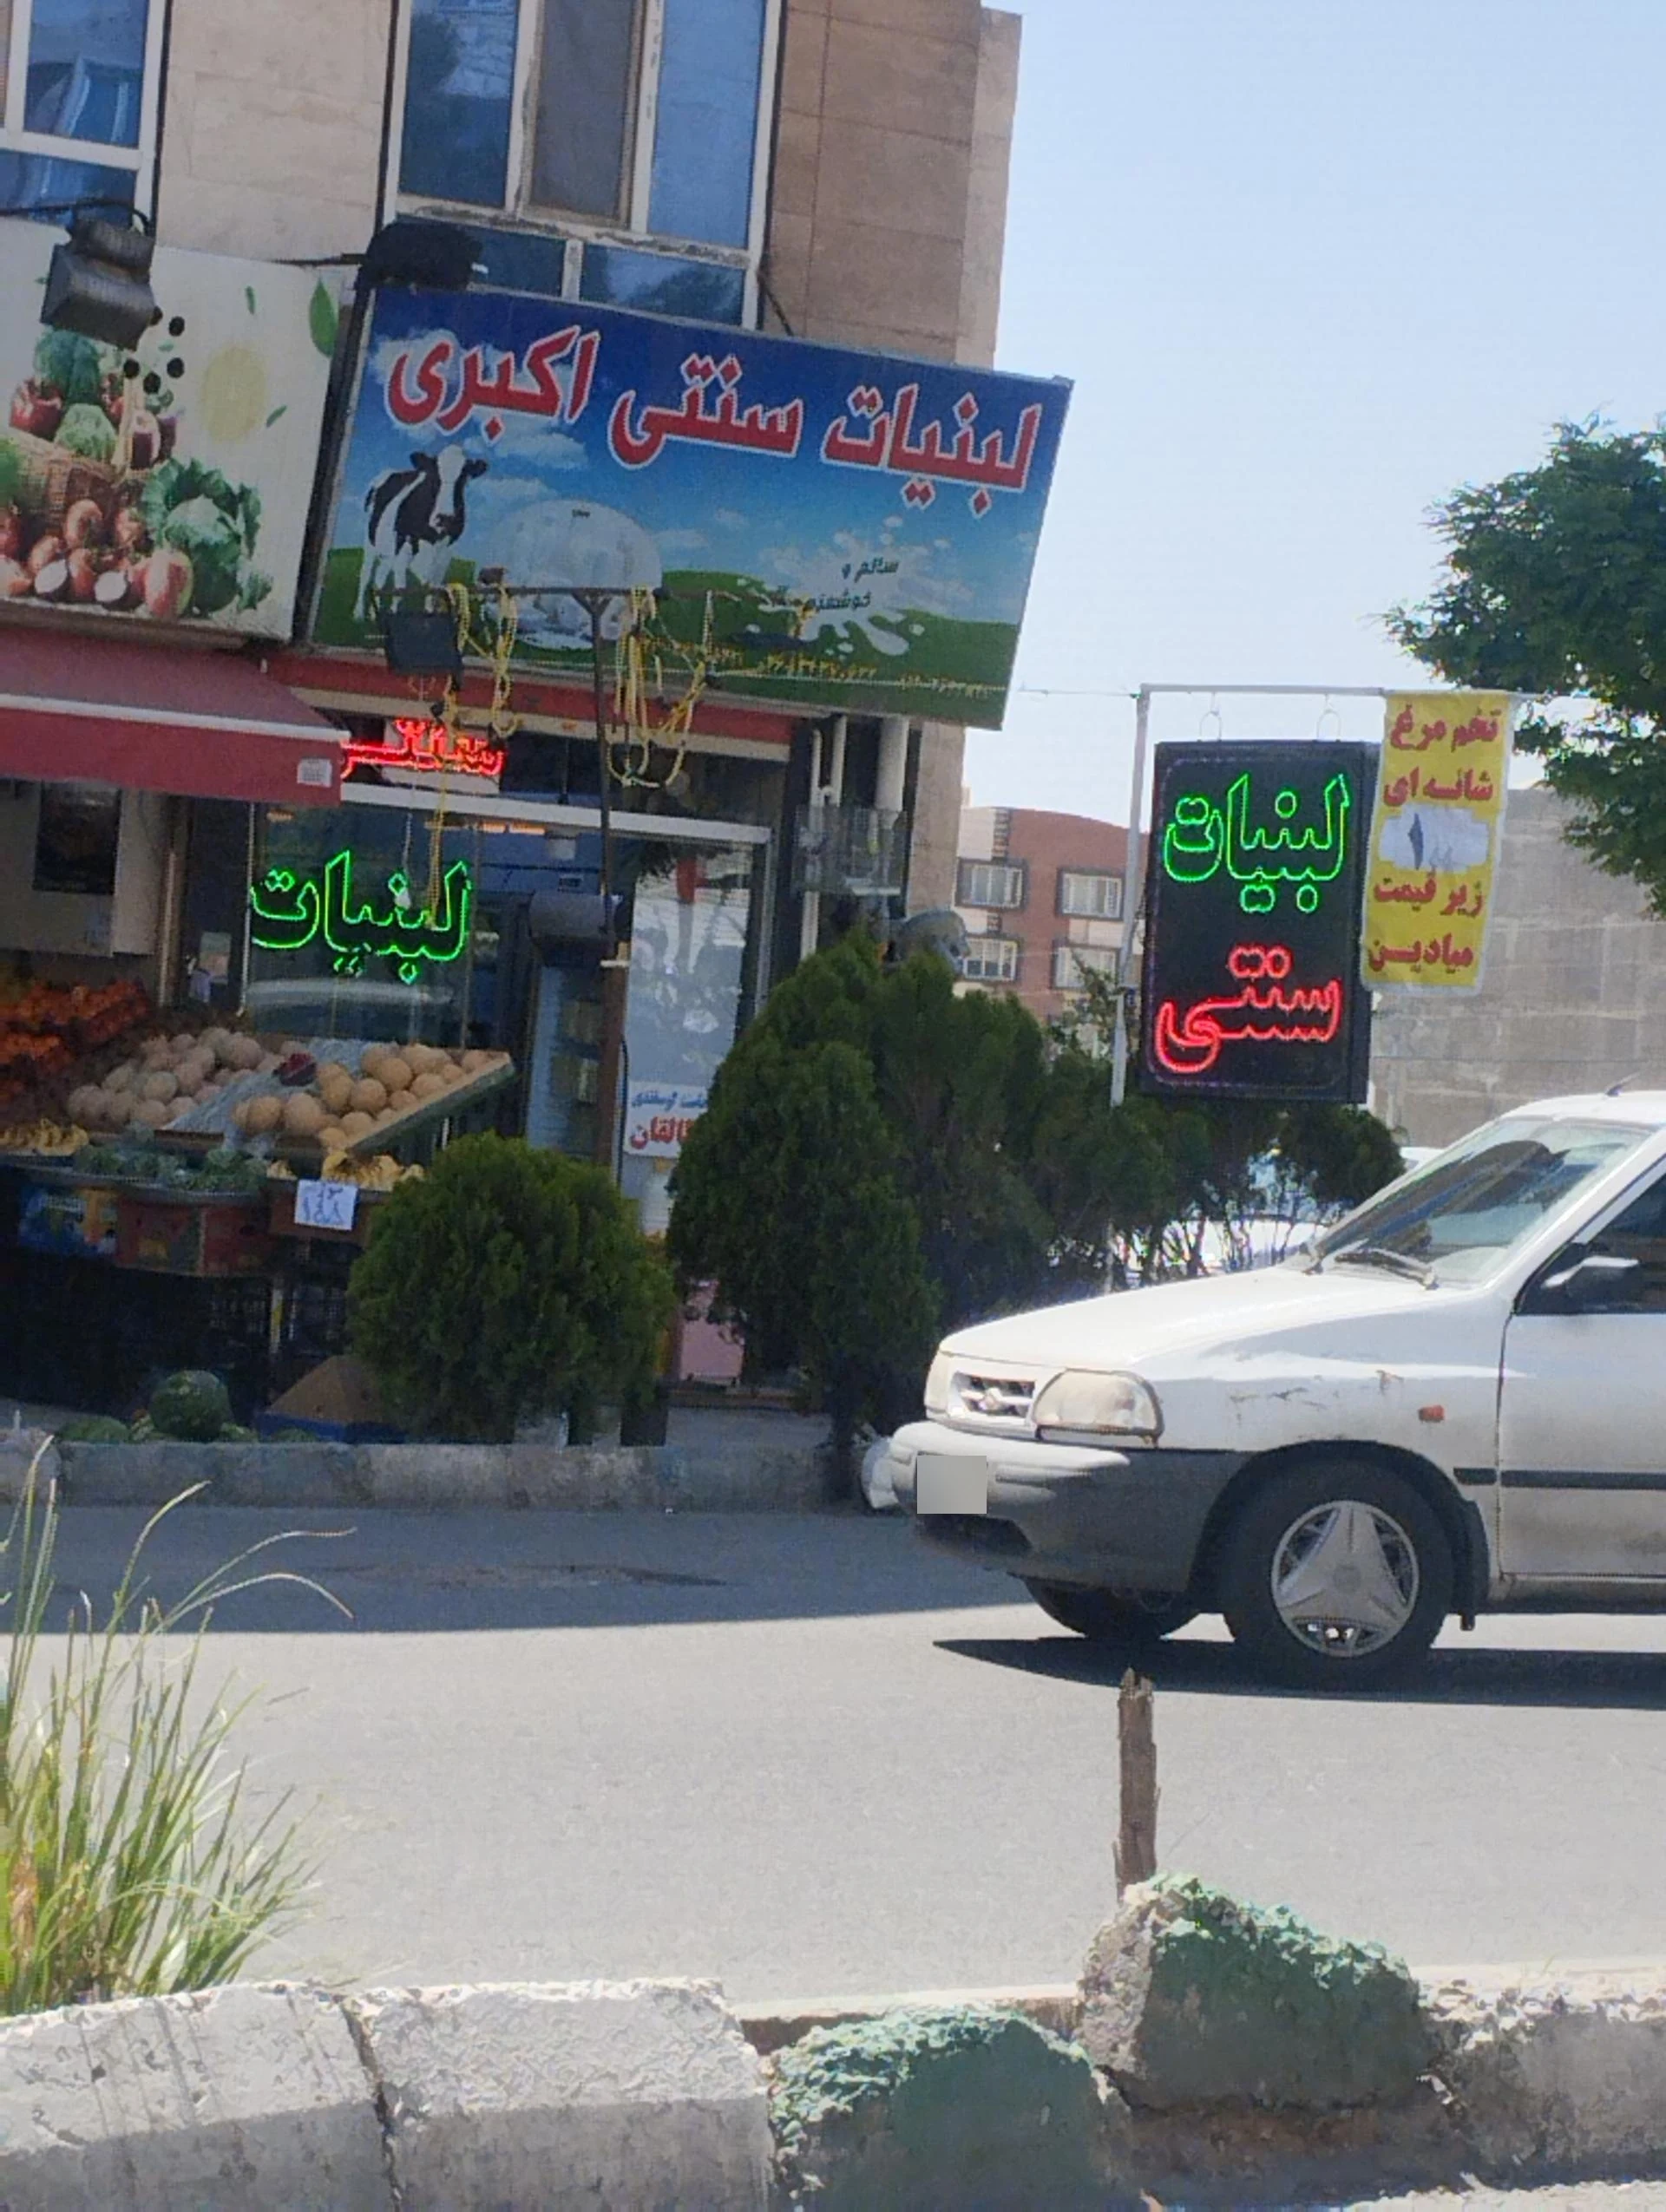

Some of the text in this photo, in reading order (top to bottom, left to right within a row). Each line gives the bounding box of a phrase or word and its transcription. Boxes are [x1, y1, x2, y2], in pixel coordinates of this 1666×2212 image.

[385, 324, 1041, 518] لبنیات سنتی اکبری
[1390, 704, 1503, 753] تخم مرغ
[1164, 772, 1351, 913] لبنیات
[1373, 870, 1438, 911] قیمت
[249, 848, 473, 985] لبنیات
[1368, 933, 1474, 974] میادین
[1155, 941, 1344, 1075] سنتی
